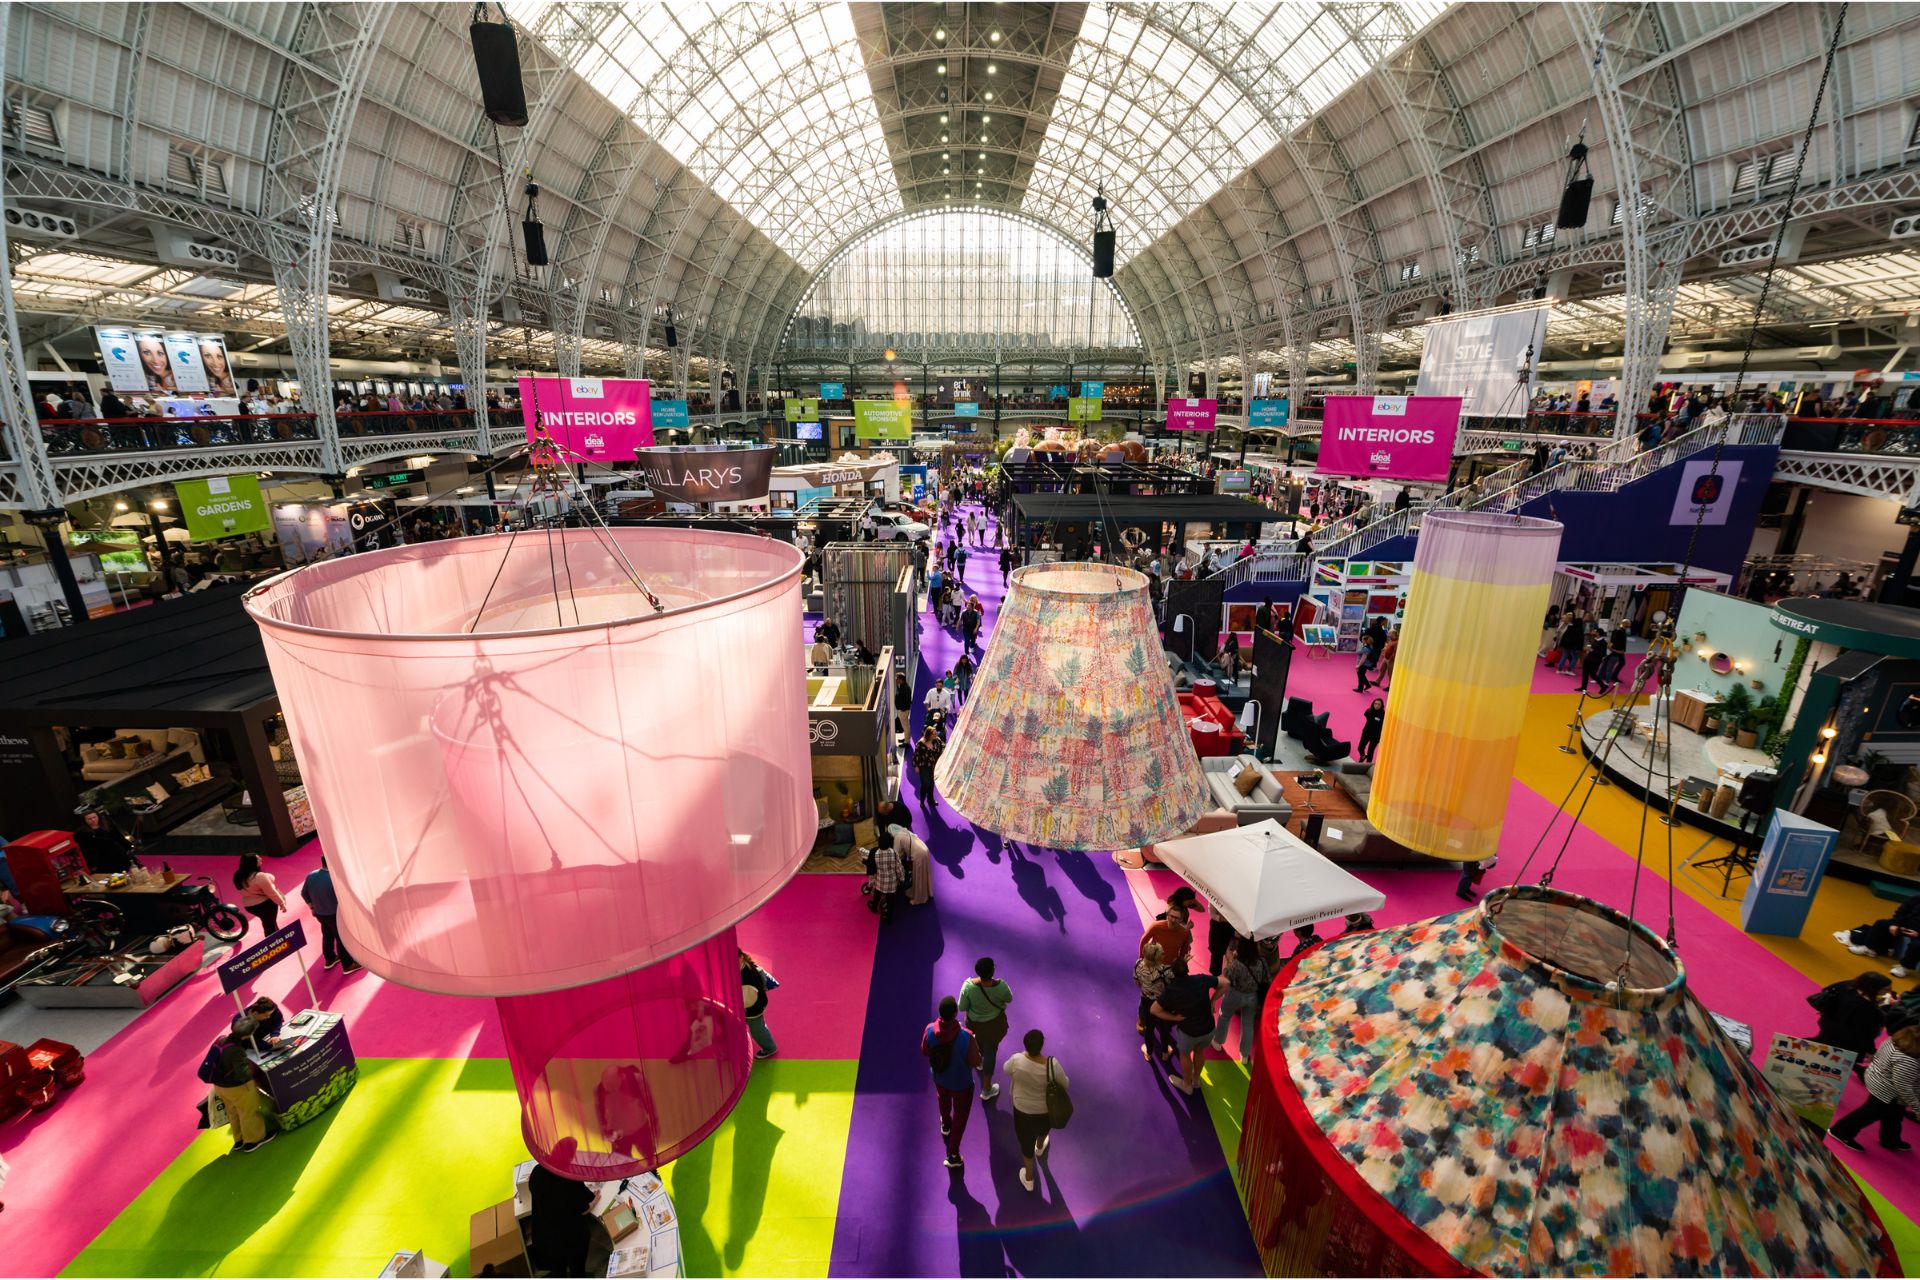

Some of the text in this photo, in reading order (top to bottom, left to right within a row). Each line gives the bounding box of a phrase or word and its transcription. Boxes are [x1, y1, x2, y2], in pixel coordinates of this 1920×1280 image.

[1455, 342, 1494, 360] STYLE
[576, 385, 598, 395] ebay
[953, 389, 971, 398] drink
[1377, 402, 1401, 413] ebay
[544, 411, 636, 426] INTERIORS
[1338, 427, 1436, 444] INTERIORS
[644, 466, 742, 489] HILLARYS
[821, 470, 863, 484] HONDA
[196, 500, 252, 516] GARDENS
[364, 514, 385, 524] OGAWA
[1777, 614, 1820, 634] RETREAT
[1182, 869, 1224, 909] Laurent-Perrier
[1289, 907, 1344, 927] Laurent-Perrier
[229, 930, 295, 972] You could win up
[241, 941, 288, 974] to £10,000
